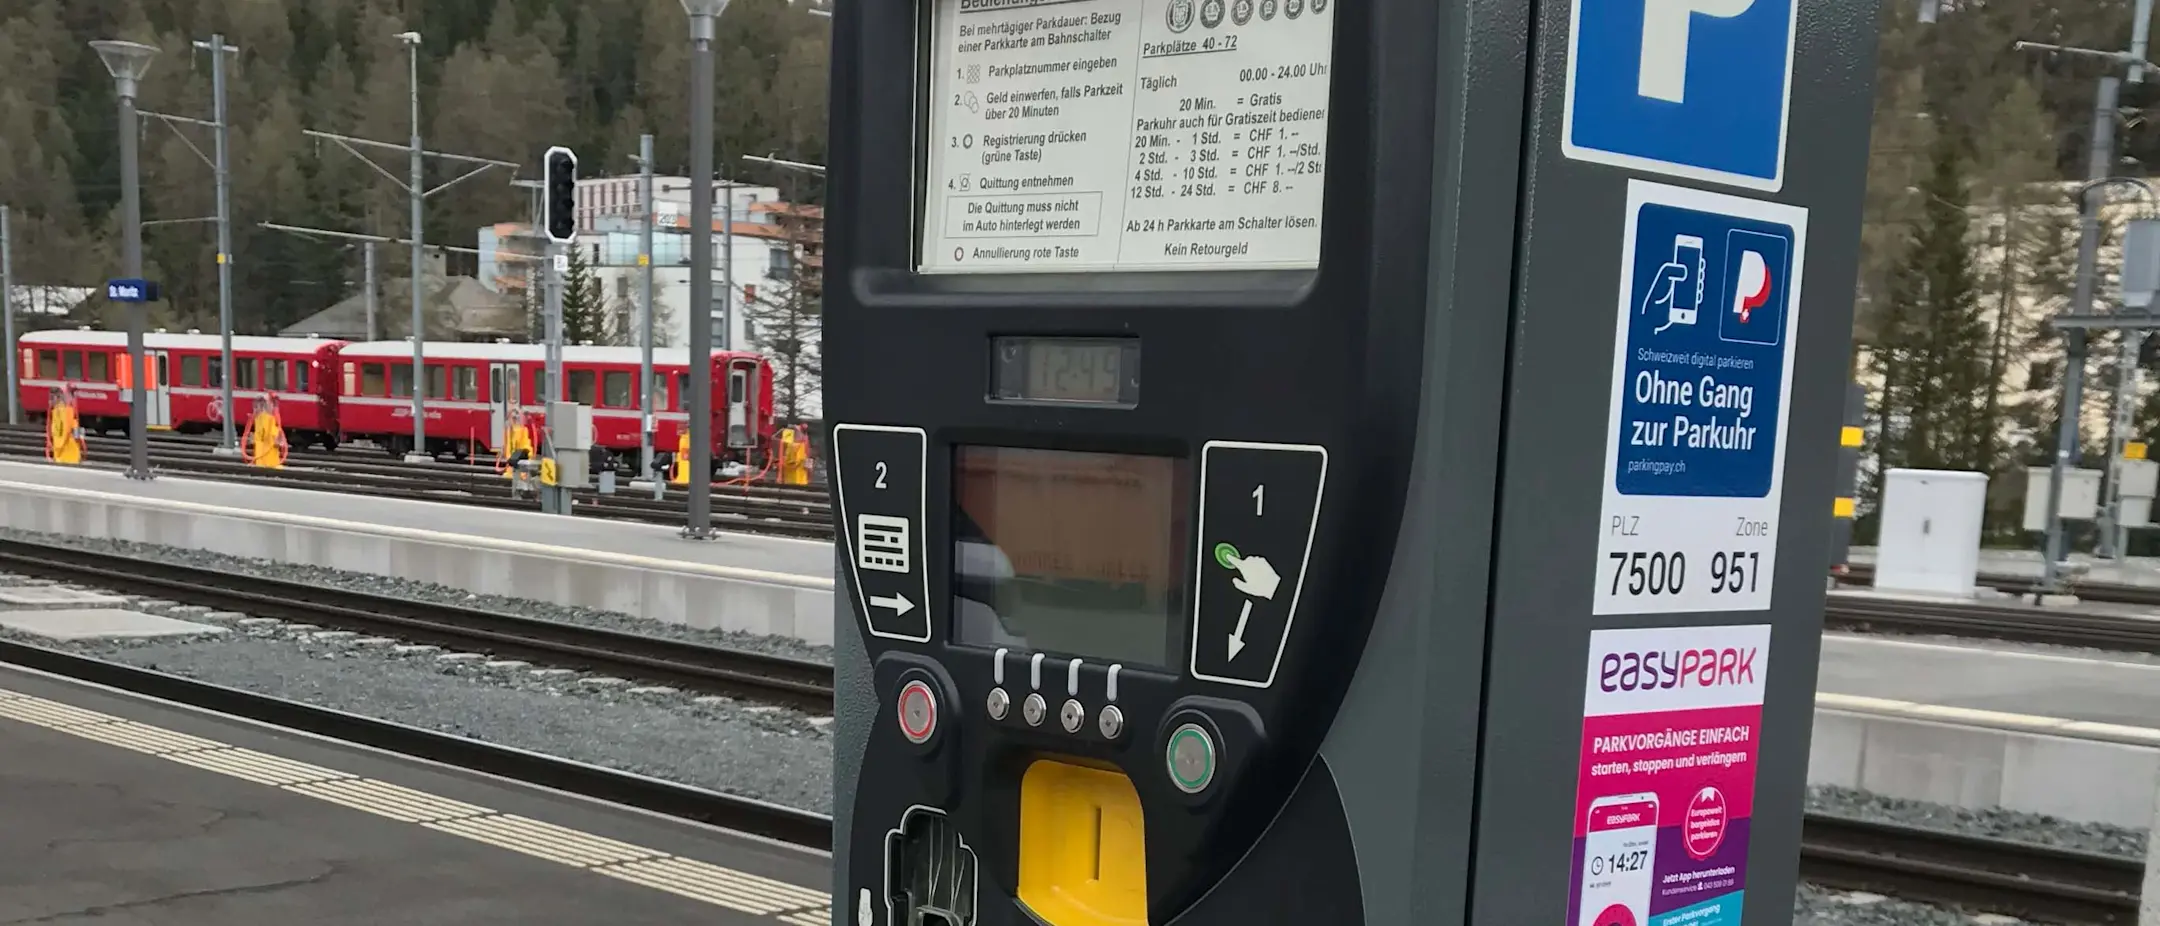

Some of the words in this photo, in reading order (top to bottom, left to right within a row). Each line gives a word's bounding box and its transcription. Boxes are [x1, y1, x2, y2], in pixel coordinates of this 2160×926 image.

[960, 25, 975, 37] Bei
[977, 20, 1033, 38] mehrtägiger
[1036, 15, 1088, 30] Parkdauer:
[1090, 11, 1121, 26] Bezug
[958, 41, 982, 53] einer
[984, 36, 1028, 50] Parkkarte
[1031, 35, 1045, 46] am
[1048, 29, 1112, 45] Bahnschalter
[1143, 39, 1196, 56] Parkplätze
[1202, 38, 1215, 49] 40
[1225, 35, 1237, 48] 72
[956, 68, 964, 79] 1.
[988, 61, 1071, 78] Parkplatznummer
[1073, 57, 1117, 72] eingeben
[1141, 75, 1177, 91] Täglich
[1240, 68, 1268, 82] 00.00
[1277, 64, 1306, 79] 24.00
[954, 95, 962, 105] 2.
[986, 91, 1008, 104] Geld
[1010, 88, 1058, 103] einwerfen,
[1061, 87, 1080, 100] falls
[1083, 83, 1123, 97] Parkzeit
[1180, 98, 1192, 111] 20
[1194, 97, 1216, 110] Min.
[1250, 93, 1282, 106] Gratis
[985, 108, 1006, 120] über
[1008, 107, 1020, 118] 20
[1021, 105, 1059, 117] Minuten
[1137, 117, 1176, 131] Parkuhr
[1179, 115, 1204, 128] auch
[1207, 113, 1222, 127] für
[1225, 109, 1277, 126] Gratiszeit
[951, 137, 959, 148] 3.
[983, 132, 1045, 149] Registrierung
[1048, 131, 1087, 143] drücken
[1135, 136, 1147, 148] 20
[1149, 135, 1171, 147] Min.
[1192, 134, 1197, 144] 1
[1200, 132, 1221, 144] Std.
[1249, 128, 1272, 141] CHF
[982, 152, 1011, 165] (grüne
[1014, 149, 1042, 163] Taste)
[1139, 153, 1145, 165] 2
[1148, 151, 1168, 164] Std.
[1190, 150, 1196, 162] 3
[1199, 149, 1219, 161] Std.
[1247, 146, 1271, 159] CHF
[1135, 171, 1141, 181] 4
[1143, 168, 1163, 181] Std.
[1183, 168, 1196, 180] 10
[1198, 166, 1218, 178] Std.
[1246, 163, 1269, 176] CHF
[948, 179, 956, 189] 4.
[979, 177, 1019, 191] Quittung
[1021, 176, 1073, 187] entnehmen
[1130, 187, 1142, 198] 12
[1144, 185, 1164, 198] Std.
[1180, 184, 1193, 196] 24
[1195, 183, 1216, 196] Std.
[1243, 181, 1266, 194] CHF
[968, 202, 983, 214] Die
[984, 201, 1024, 215] Quittung
[1026, 202, 1052, 212] muss
[1054, 200, 1079, 212] nicht
[963, 221, 974, 231] im
[975, 219, 997, 231] Auto
[1000, 218, 1043, 232] hinterlegt
[1045, 218, 1080, 230] werden
[1126, 220, 1140, 231] Ab
[1142, 219, 1155, 231] 24
[1157, 219, 1164, 230] h
[1167, 218, 1216, 231] Parkkarte
[1218, 219, 1235, 230] am
[1237, 215, 1282, 229] Schalter
[1285, 214, 1317, 228] lösen.
[973, 247, 1031, 260] Annullierung
[1033, 247, 1051, 258] rote
[1054, 245, 1079, 258] Taste
[1164, 243, 1187, 255] Kein
[1190, 241, 1248, 257] Retourgeld
[1638, 347, 1689, 365] Schweizweit
[1691, 352, 1715, 368] digital
[1717, 355, 1753, 369] parkieren
[1635, 369, 1692, 405] Ohne
[1700, 376, 1753, 417] Gang
[1631, 419, 1667, 446] zur
[1673, 415, 1756, 450] Parkuhr
[875, 461, 888, 489] 2
[1628, 458, 1685, 476] parkingpay.ch
[1251, 484, 1265, 517] 1
[1612, 515, 1640, 536] PLZ
[1736, 517, 1768, 537] Zone
[1609, 551, 1685, 596] 7500
[1711, 551, 1759, 594] 951
[1593, 728, 1697, 754] PARKVORGÄNGE
[1700, 726, 1749, 744] EINFACH
[1591, 762, 1631, 776] starten,
[1633, 758, 1674, 775] stoppen
[1676, 754, 1695, 768] und
[1697, 751, 1747, 768] verlängern
[1609, 851, 1648, 874] 14:27
[1663, 873, 1679, 884] Jetzt
[1679, 871, 1693, 883] App
[1693, 866, 1735, 880] herunterladen
